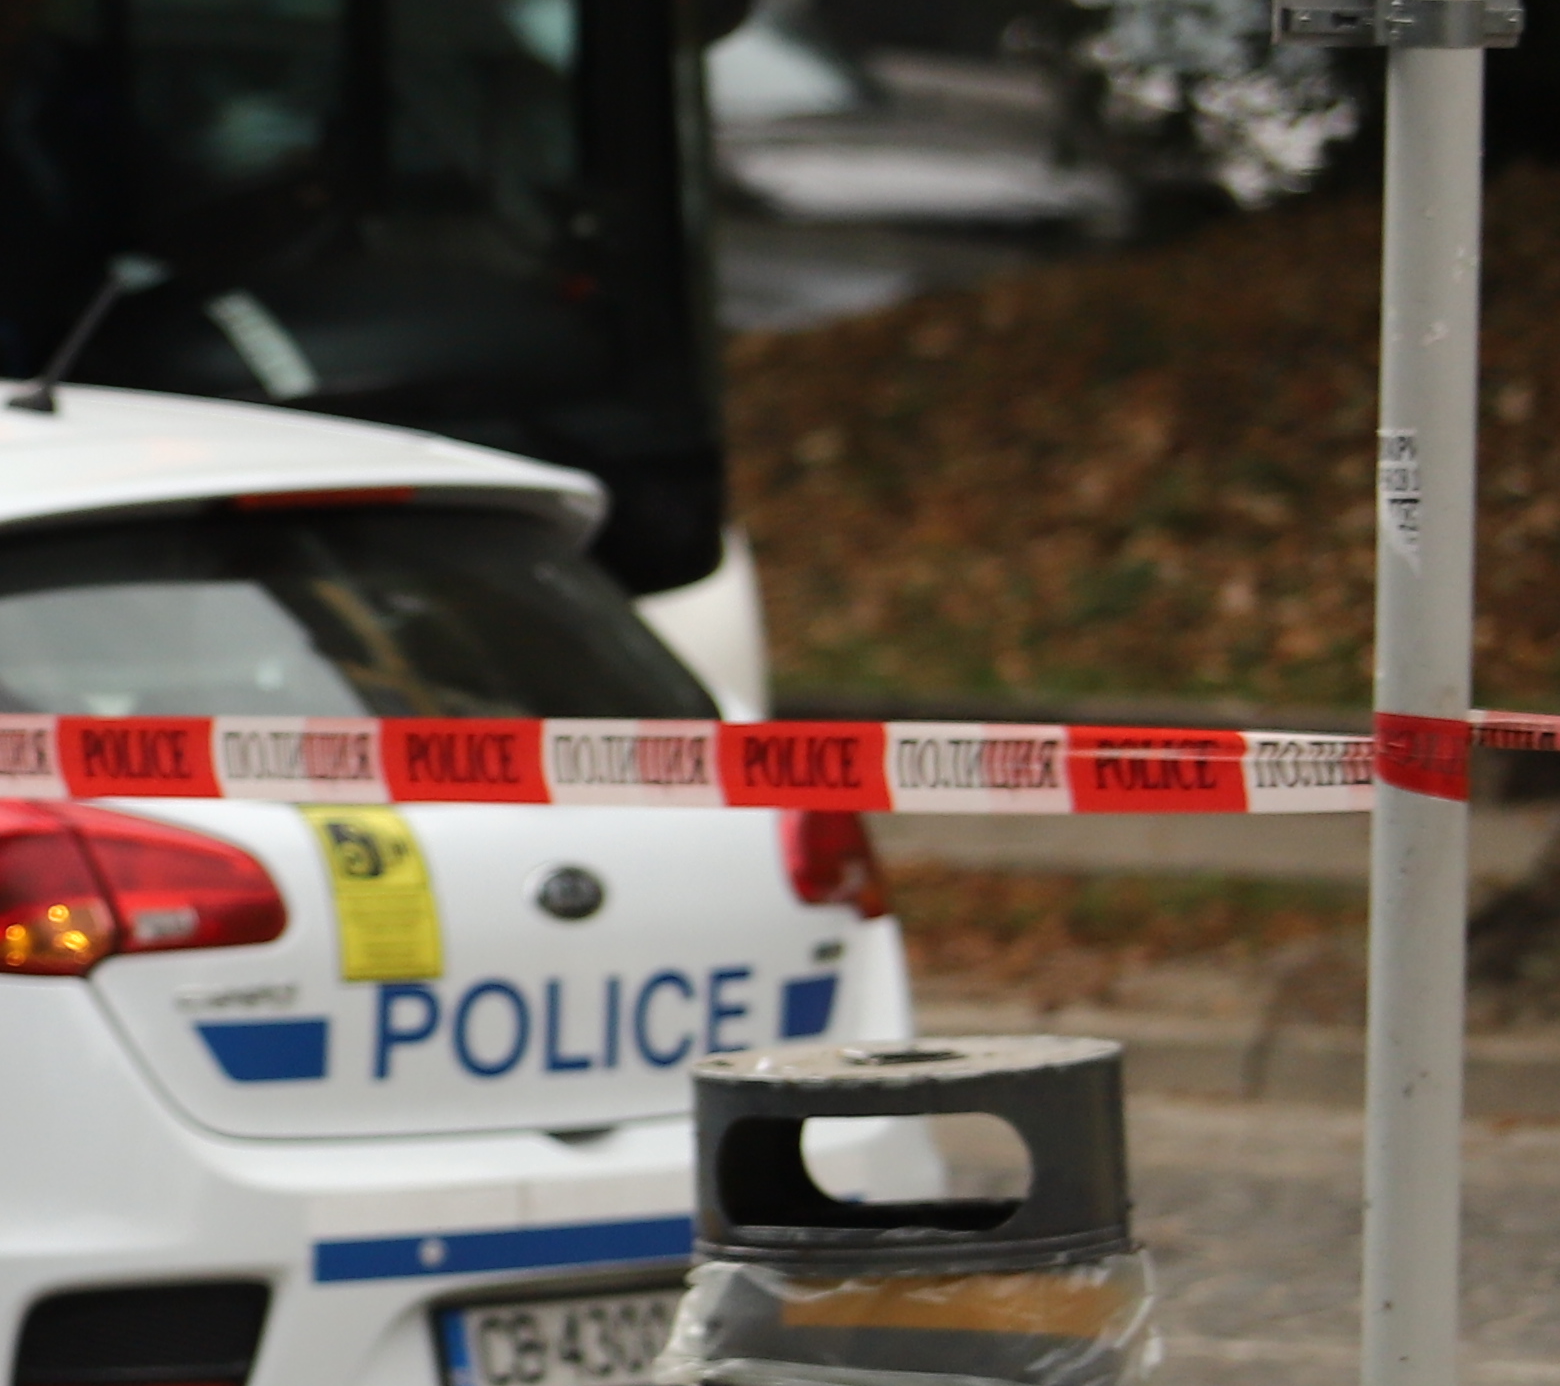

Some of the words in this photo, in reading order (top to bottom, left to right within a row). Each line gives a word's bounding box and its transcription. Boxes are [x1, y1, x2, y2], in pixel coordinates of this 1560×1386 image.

[82, 728, 193, 780] POLICE
[405, 732, 520, 785] POLICE
[743, 735, 862, 789] POLICE
[1094, 740, 1219, 790] POLICE
[370, 966, 754, 1082] POLICE
